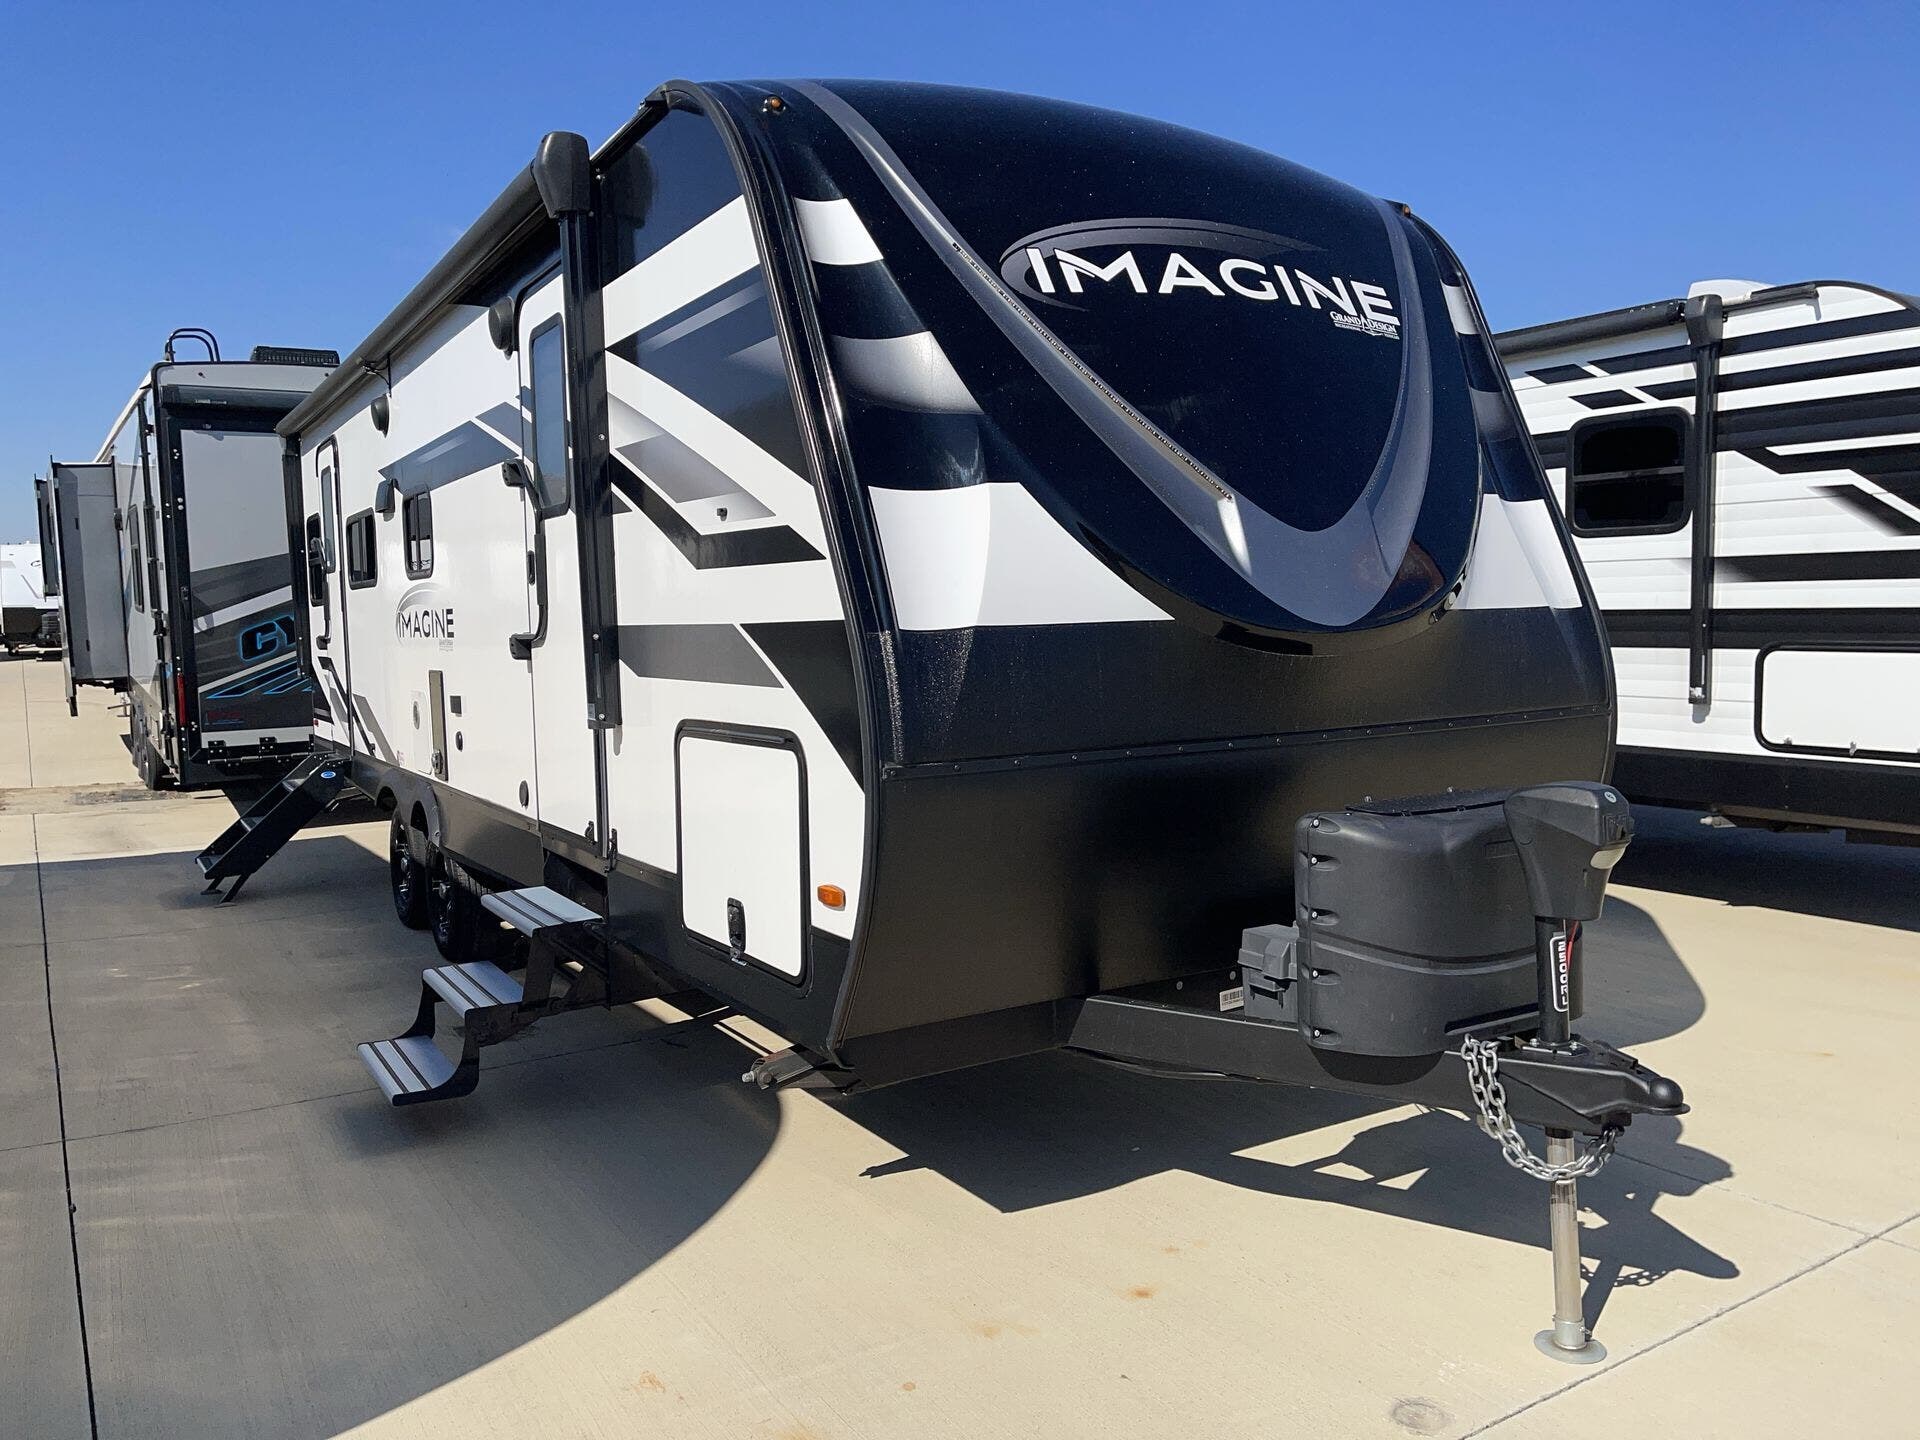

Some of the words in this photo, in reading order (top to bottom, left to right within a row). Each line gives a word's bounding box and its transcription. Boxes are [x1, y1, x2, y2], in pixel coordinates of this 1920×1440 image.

[1025, 247, 1400, 326] IMAGINE
[1329, 311, 1361, 326] GRAND
[1367, 318, 1397, 333] DESIGN
[398, 608, 454, 638] IMAGINE
